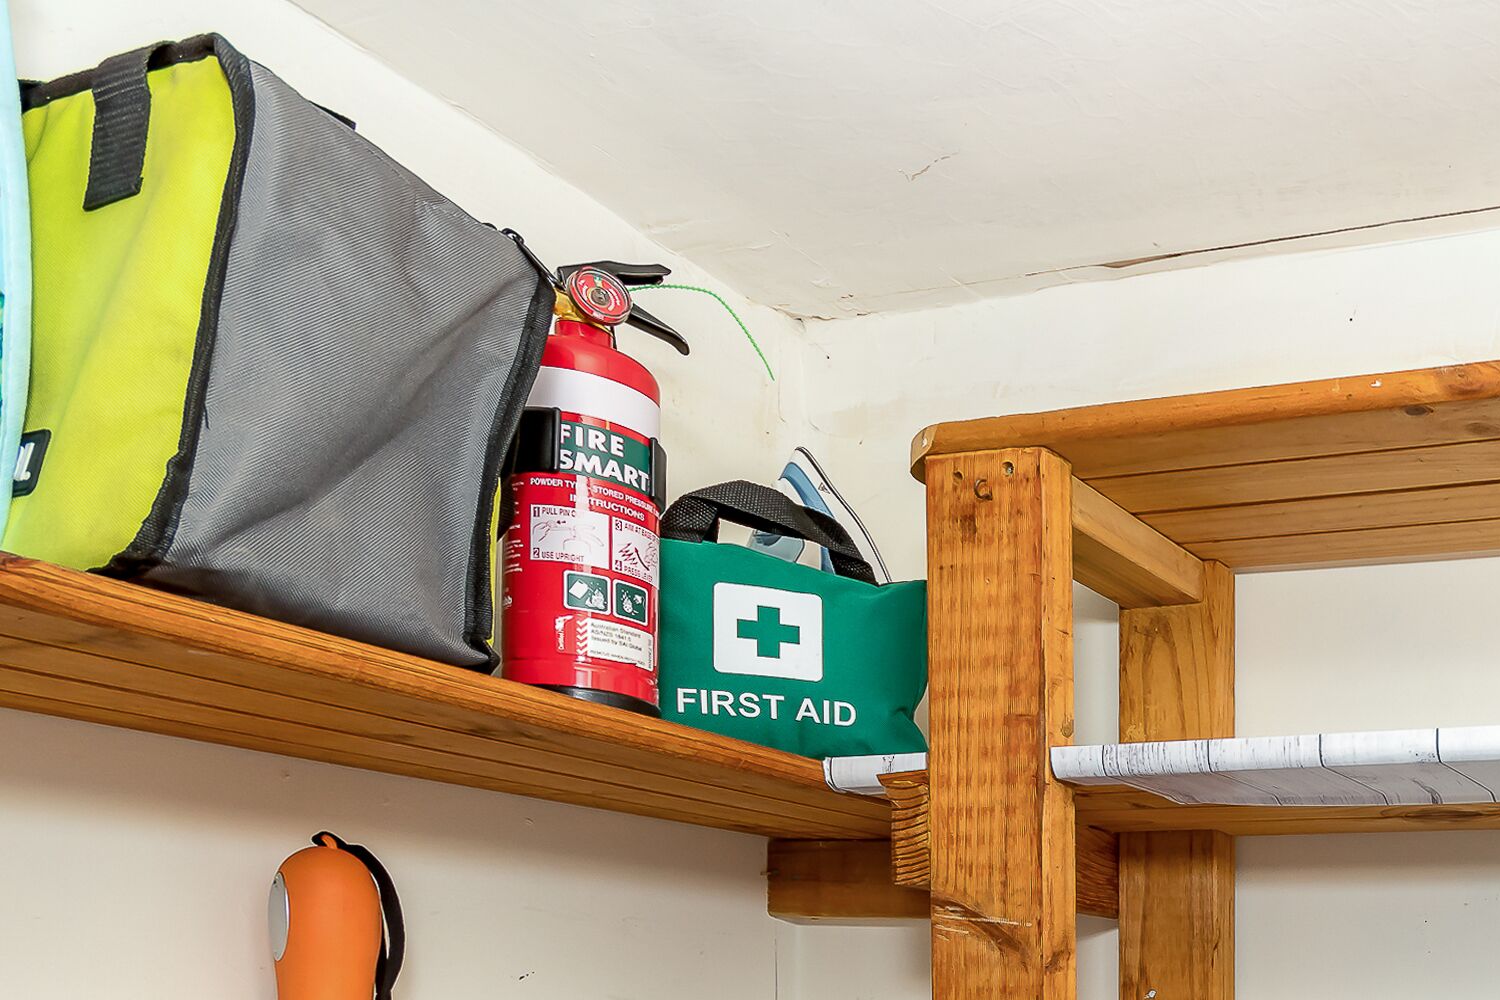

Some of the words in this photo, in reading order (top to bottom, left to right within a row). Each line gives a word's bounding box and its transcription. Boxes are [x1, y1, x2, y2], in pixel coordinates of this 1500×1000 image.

[560, 423, 625, 458] FIRE
[559, 449, 650, 492] SMART
[530, 478, 564, 488] POWDER
[592, 485, 624, 500] STORED
[542, 507, 558, 516] PULL
[542, 551, 554, 559] USE
[676, 687, 785, 720] FIRST
[795, 697, 857, 727] AID
